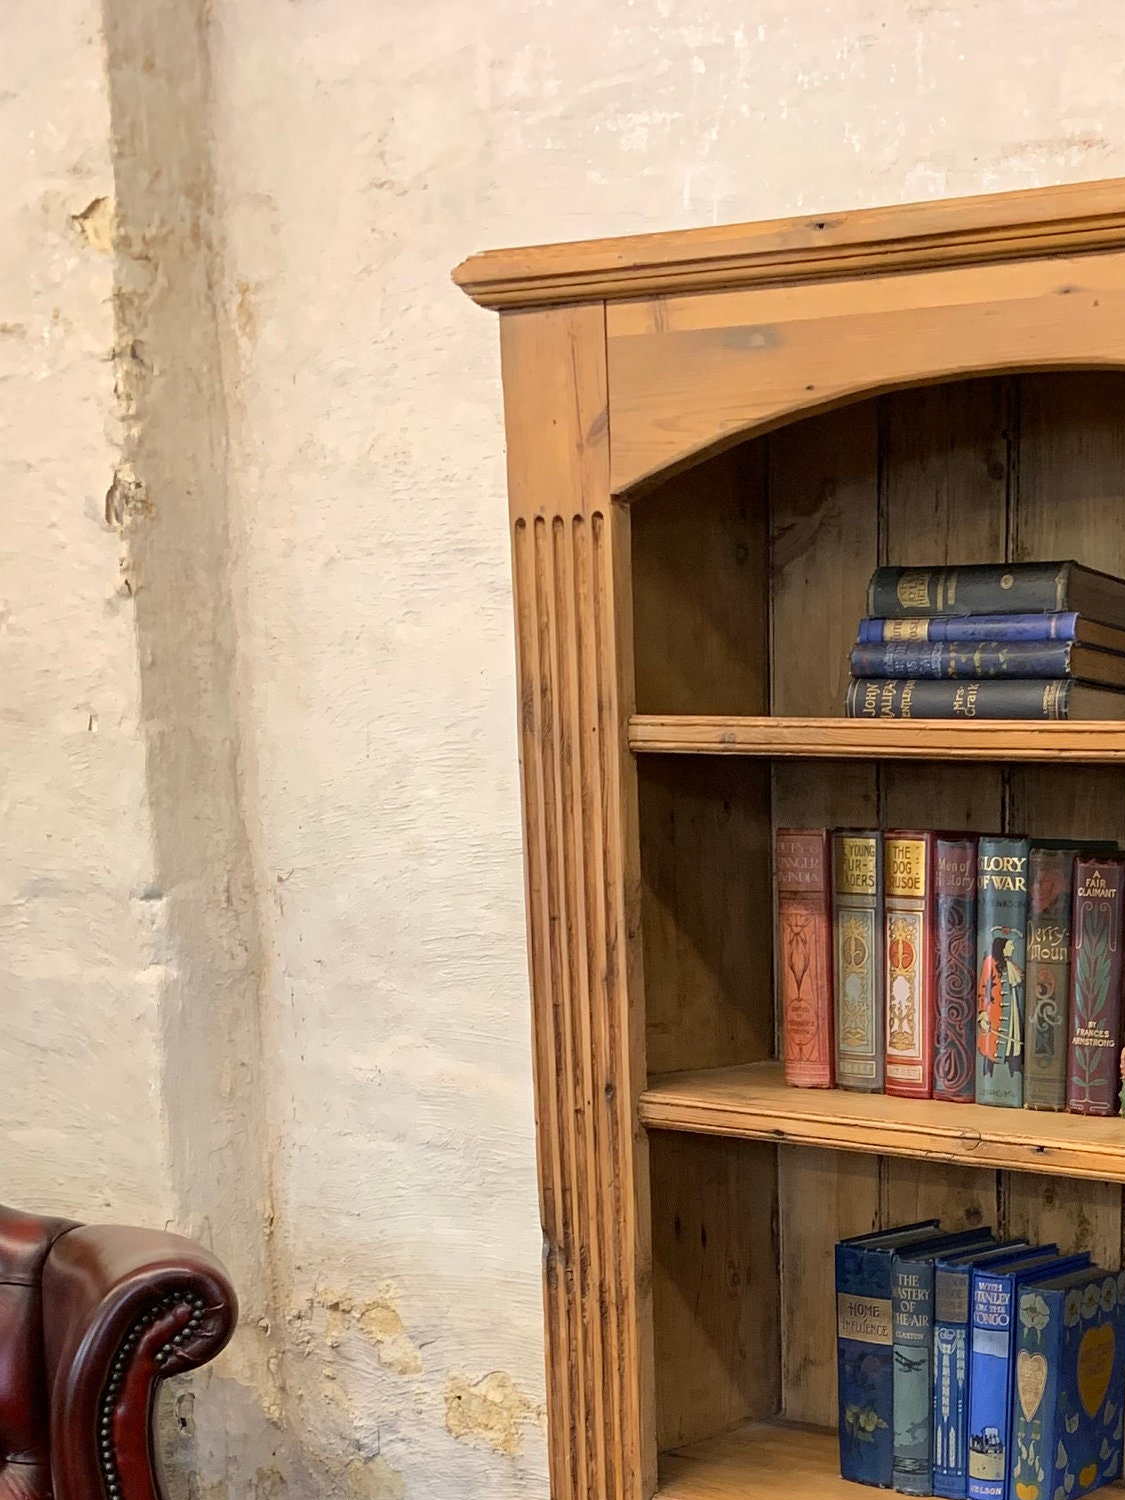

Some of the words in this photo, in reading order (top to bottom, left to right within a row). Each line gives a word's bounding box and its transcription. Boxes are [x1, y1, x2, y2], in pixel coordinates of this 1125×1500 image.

[863, 683, 880, 716] JOHN
[964, 682, 980, 717] Craik
[848, 844, 875, 858] YOUNG
[893, 846, 911, 859] THE
[892, 861, 912, 875] DOG
[960, 860, 970, 876] of
[1092, 870, 1101, 879] A
[991, 875, 1027, 891] WAR
[1085, 878, 1107, 888] FAIR
[1078, 887, 1117, 898] CLAIMANT
[1087, 1020, 1098, 1028] BY
[1076, 1028, 1110, 1038] FRANCES
[1072, 1037, 1116, 1048] ARMSTRONG
[897, 1273, 919, 1286] THE
[979, 1282, 1003, 1292] WITH
[848, 1302, 880, 1317] HOME
[901, 1301, 916, 1312] OF
[841, 1317, 888, 1336] INFLUENCE
